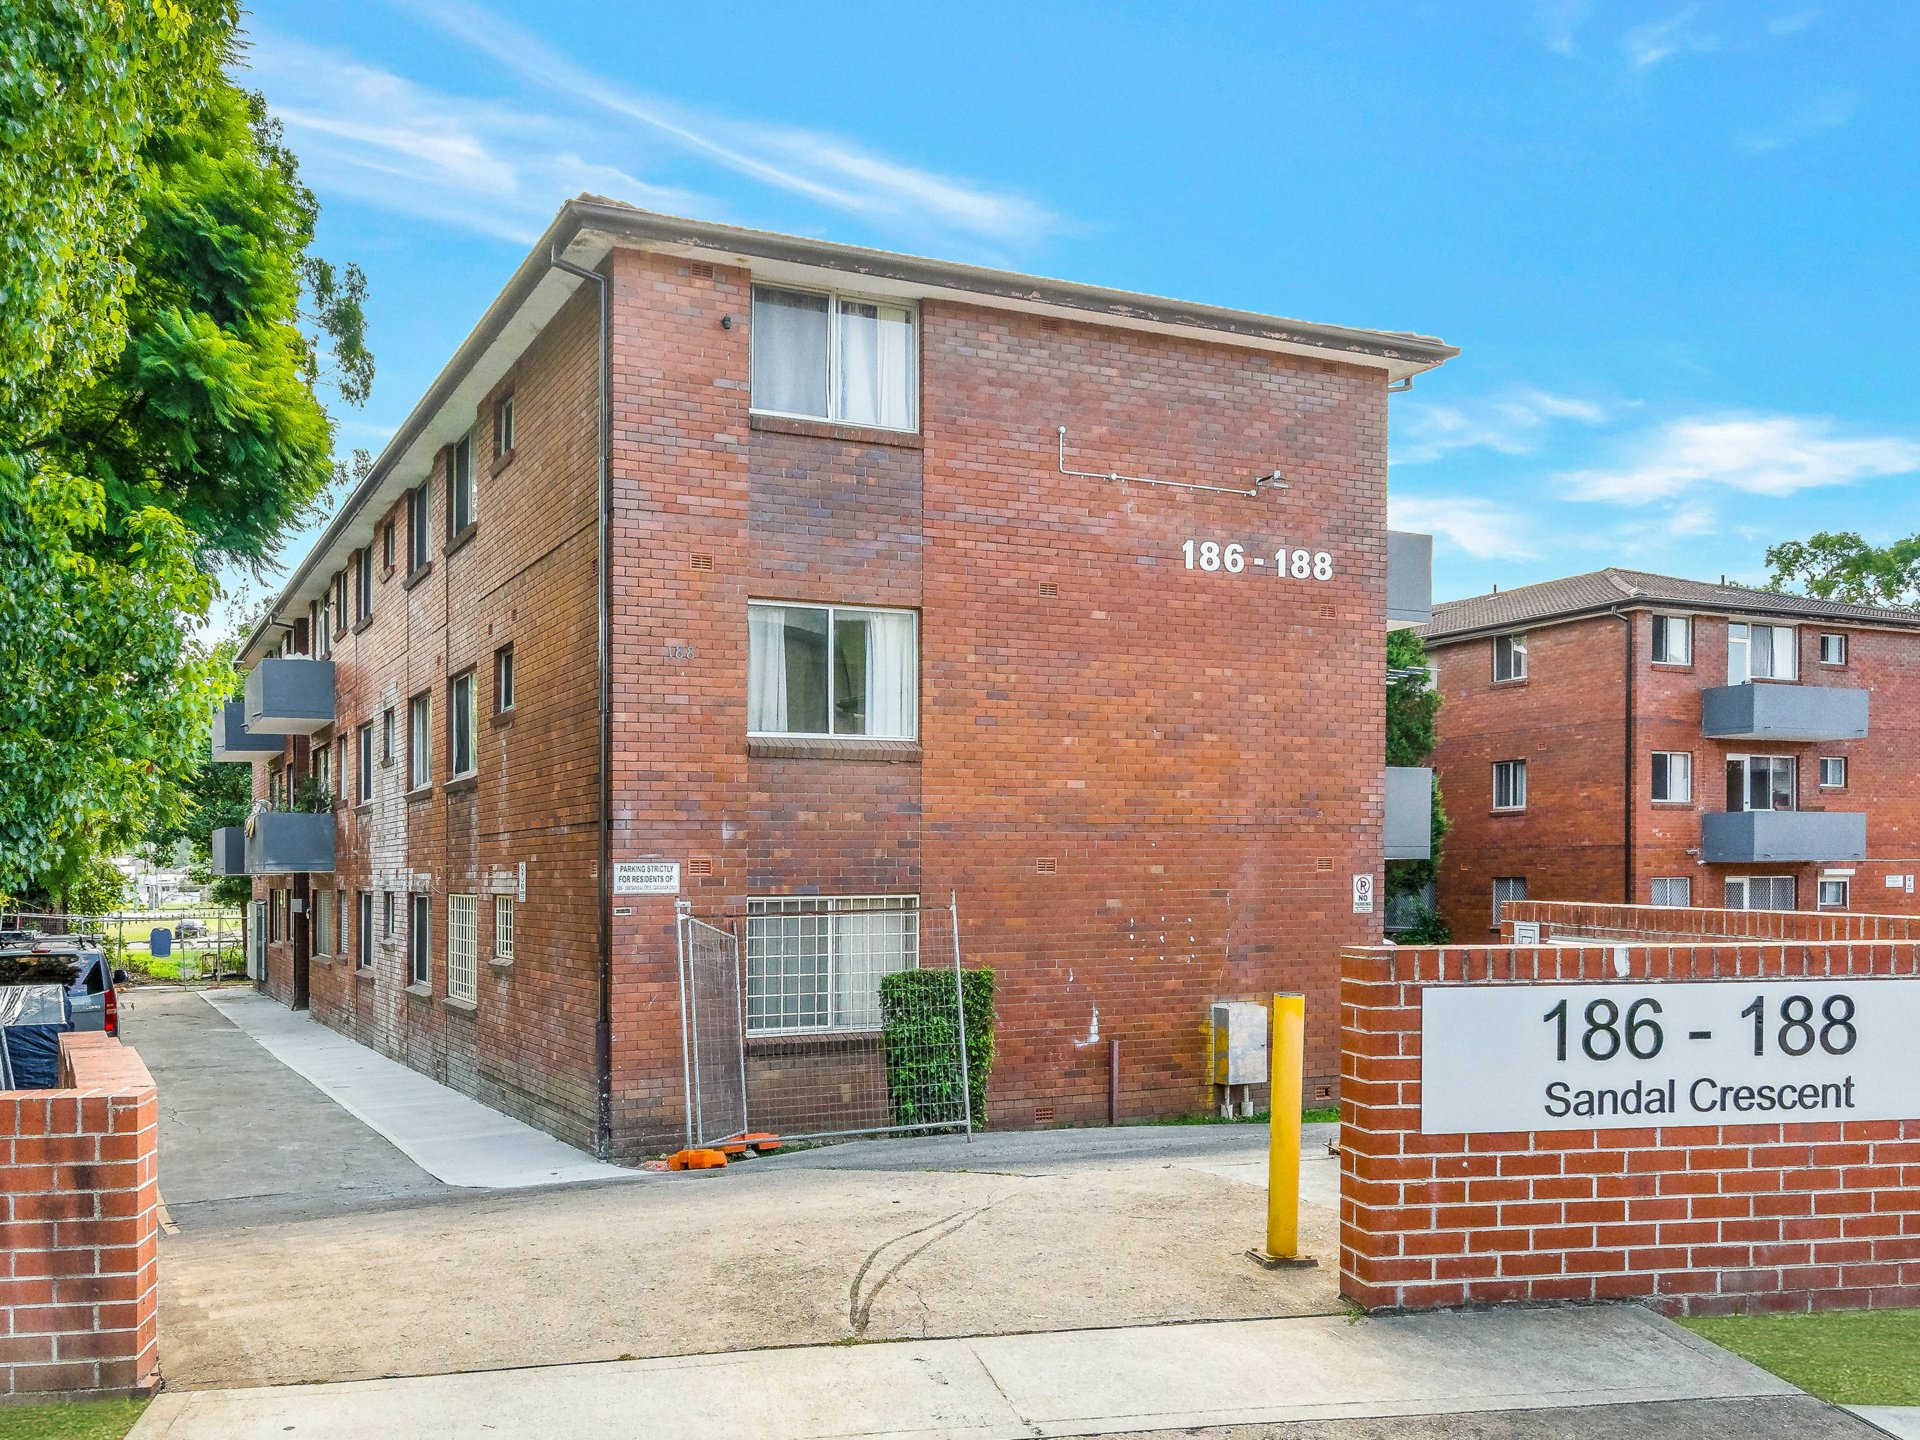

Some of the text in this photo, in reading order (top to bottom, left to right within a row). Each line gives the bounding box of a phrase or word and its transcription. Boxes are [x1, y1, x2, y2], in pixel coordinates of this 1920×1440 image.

[1182, 540, 1245, 573] 186
[1275, 548, 1333, 581] 188
[618, 875, 631, 883] FOR
[632, 875, 664, 883] RESIDENTS
[619, 865, 674, 873] PARKING STRICTLY
[1543, 994, 1858, 1061] 186 - 188
[1544, 1075, 1855, 1118] Sandal Crescent
